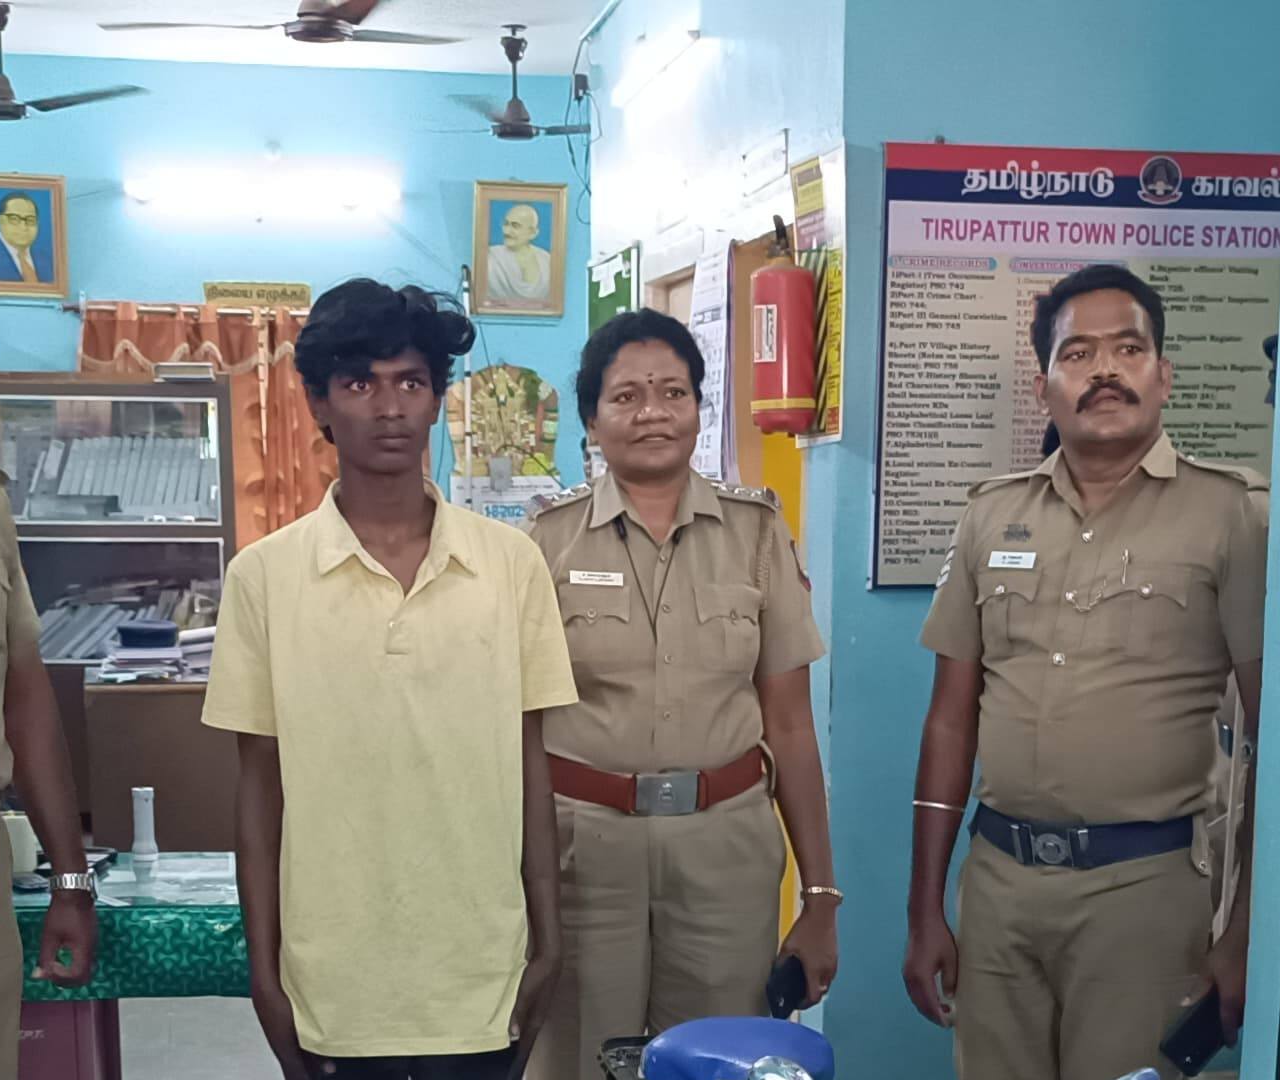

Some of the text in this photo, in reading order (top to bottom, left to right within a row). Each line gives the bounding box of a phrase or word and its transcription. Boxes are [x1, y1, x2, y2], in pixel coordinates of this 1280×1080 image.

[961, 160, 1115, 200] தமிழ்நாடு
[922, 218, 1050, 243] TIRUPATTUR
[1057, 222, 1116, 244] TOWN
[1122, 224, 1195, 246] POLICE
